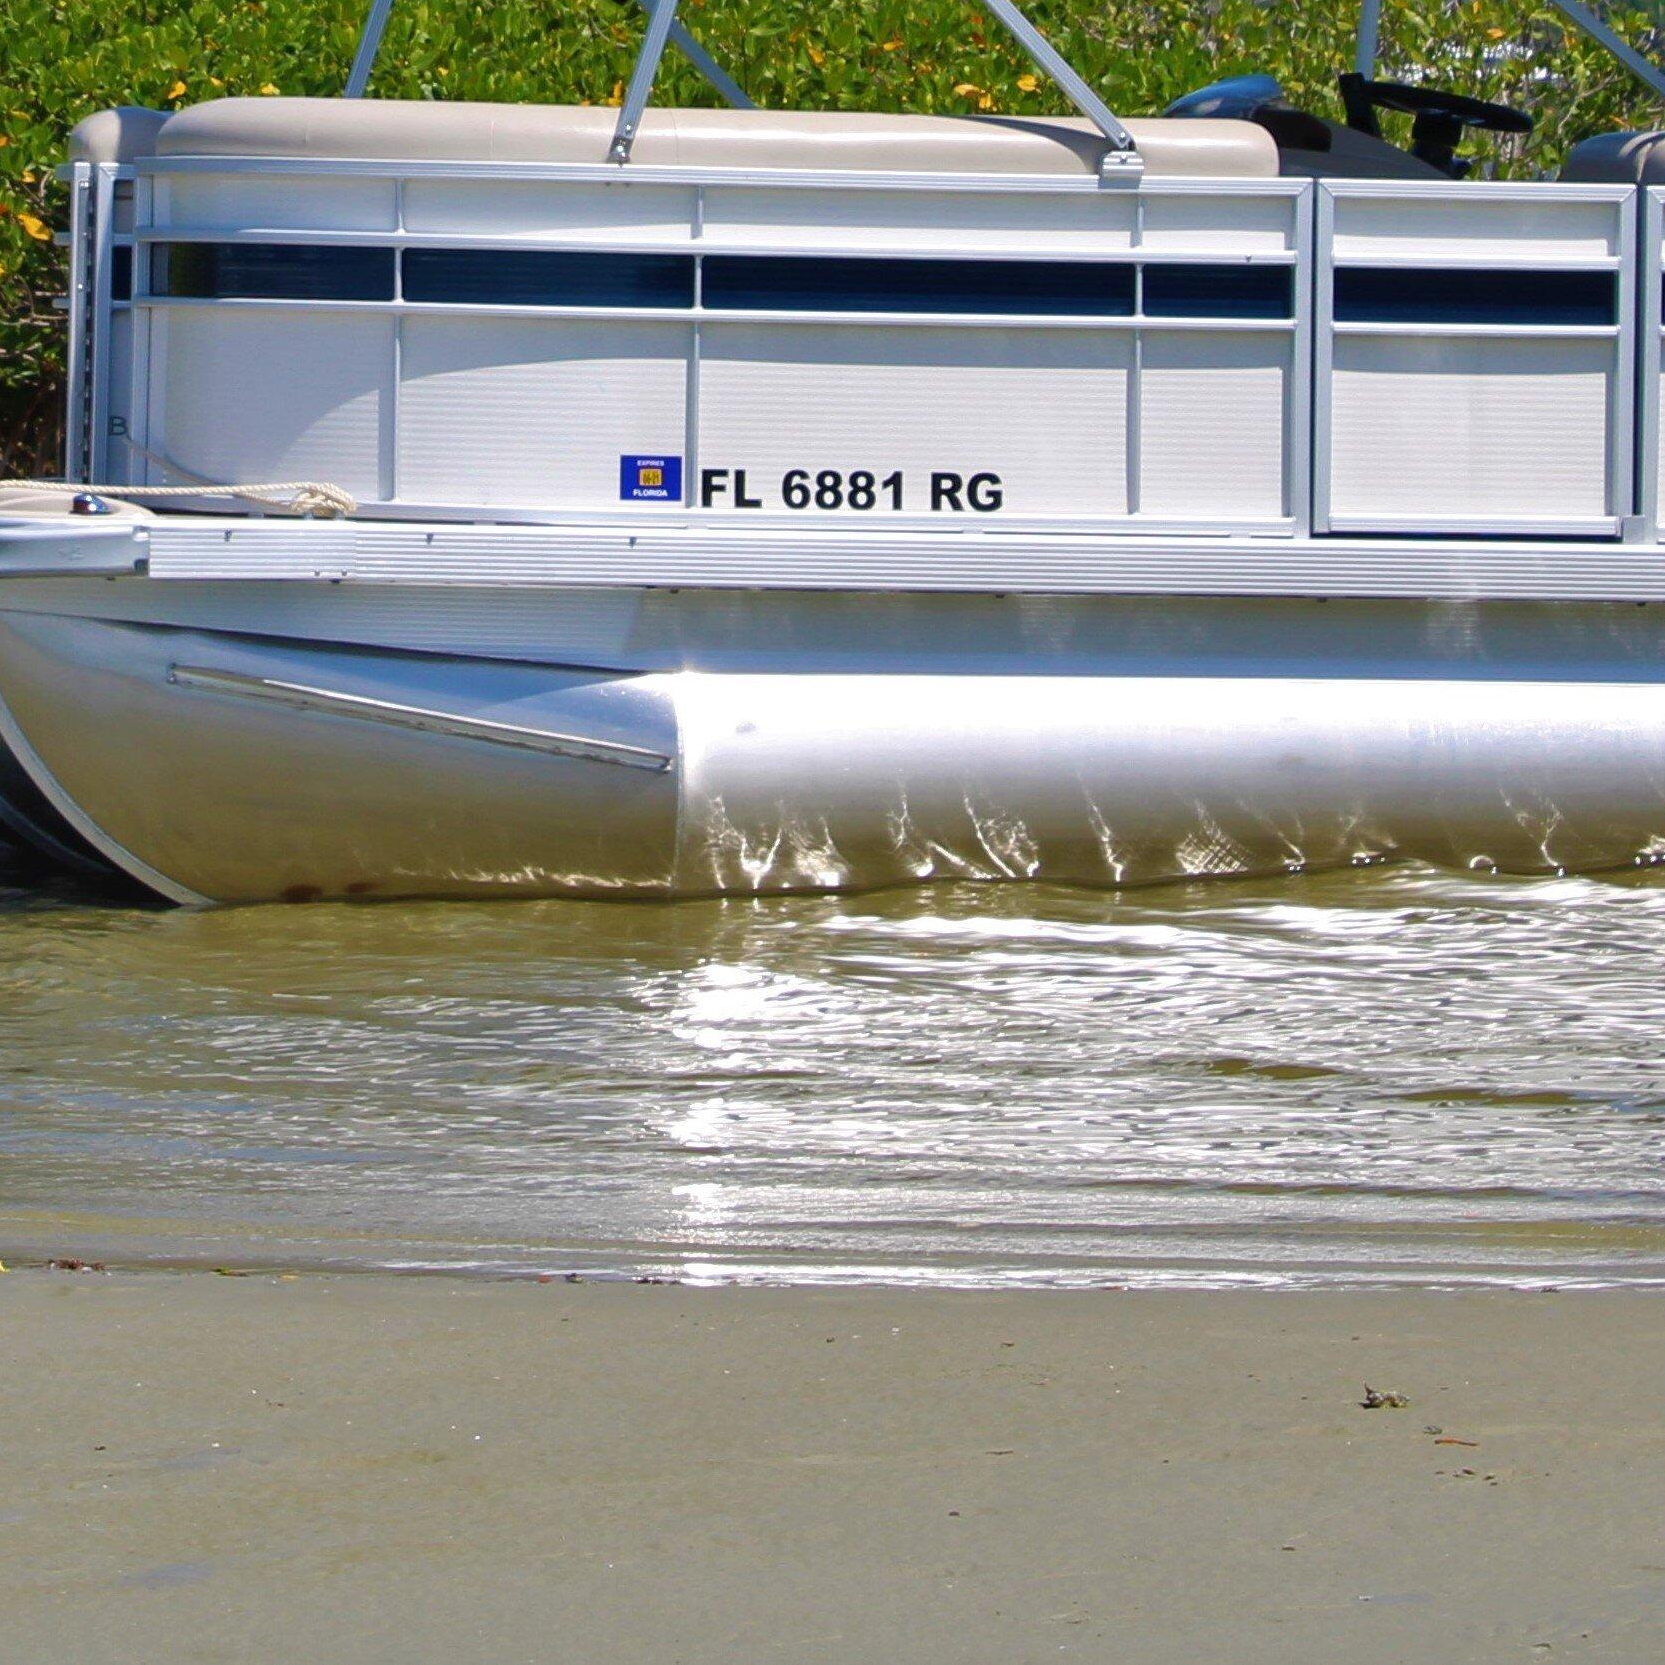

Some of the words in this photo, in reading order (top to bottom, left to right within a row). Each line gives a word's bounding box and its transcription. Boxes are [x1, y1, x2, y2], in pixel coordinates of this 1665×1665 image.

[632, 488, 668, 497] FLORIDA
[701, 468, 763, 509] FL
[781, 469, 904, 511] 6881
[930, 471, 1004, 513] RG
